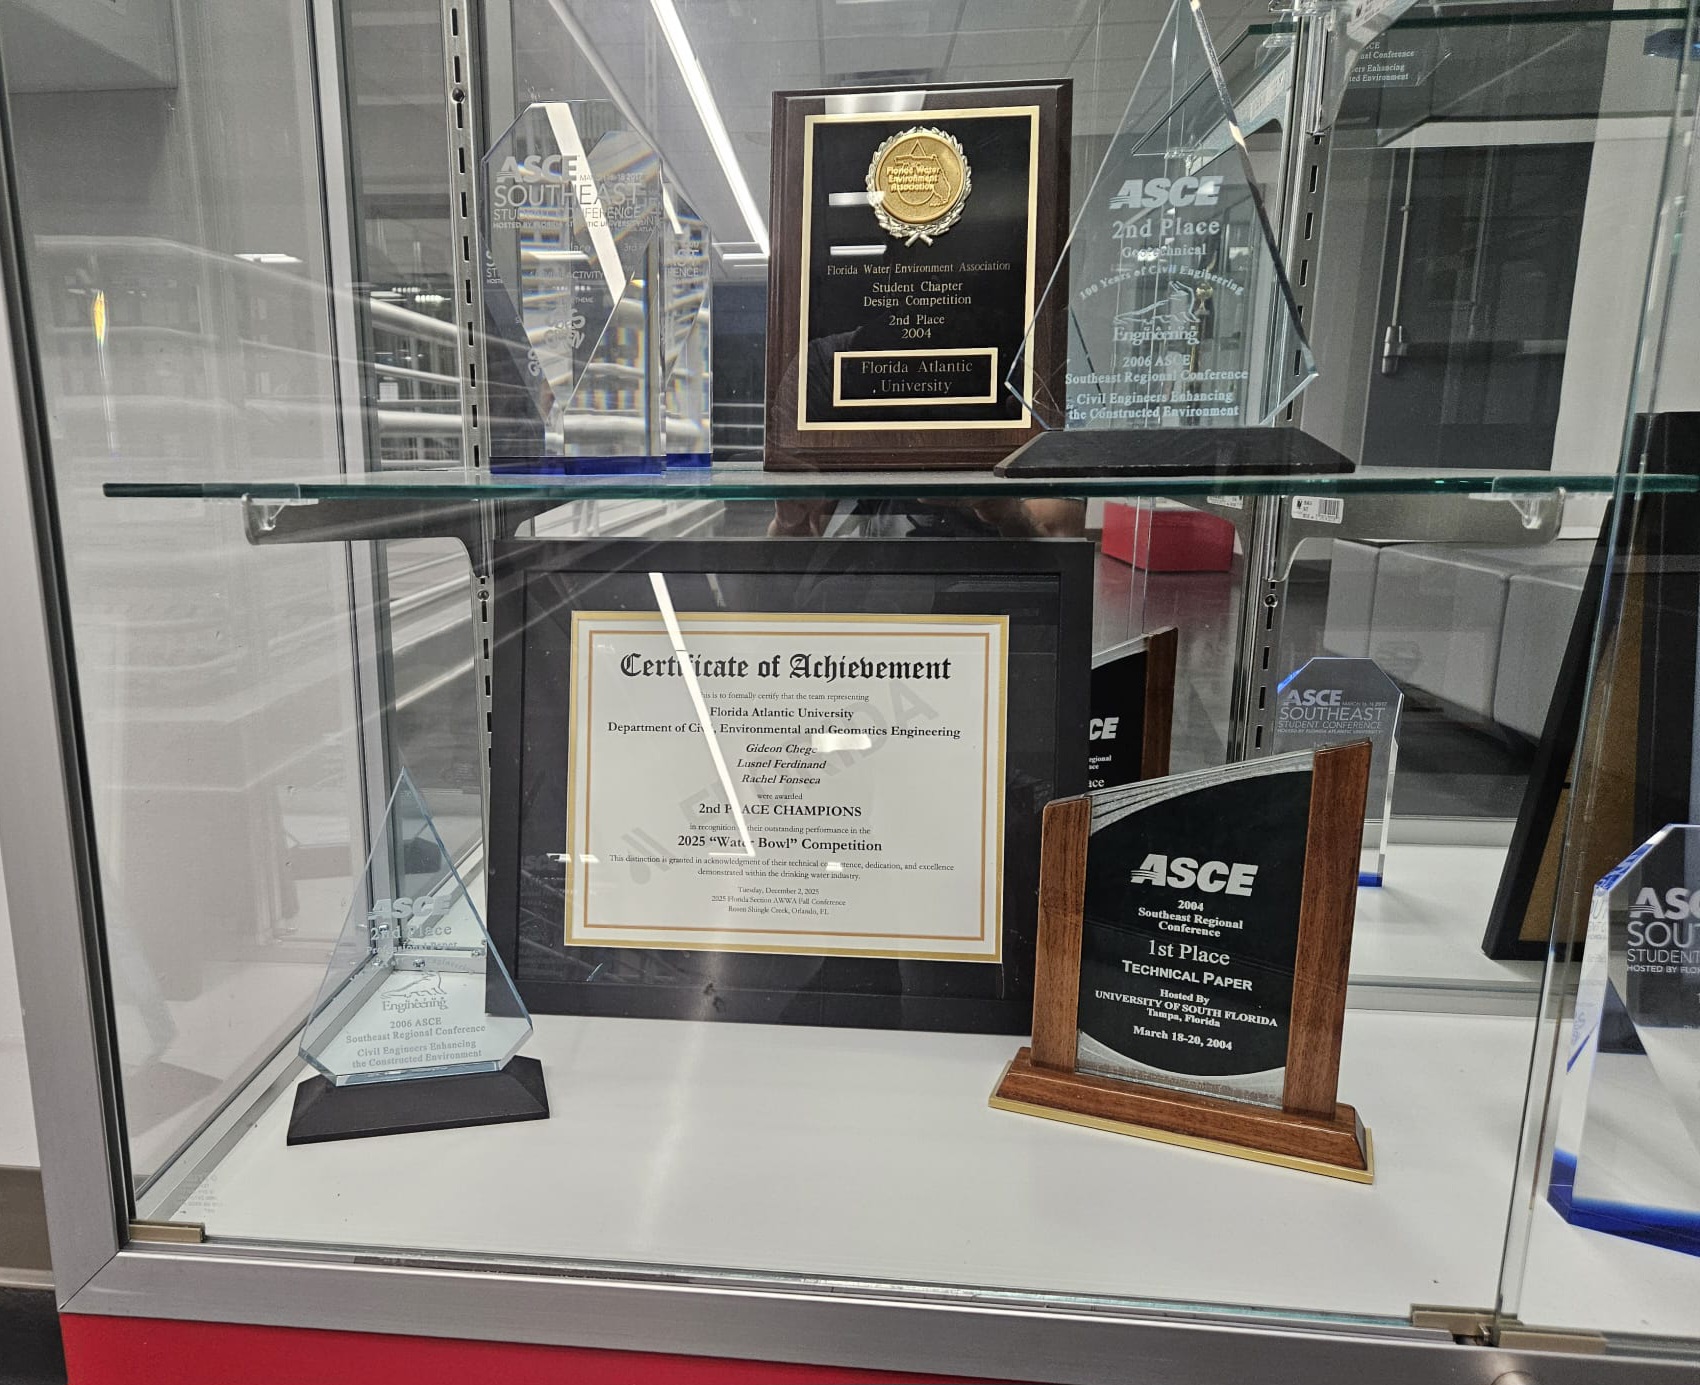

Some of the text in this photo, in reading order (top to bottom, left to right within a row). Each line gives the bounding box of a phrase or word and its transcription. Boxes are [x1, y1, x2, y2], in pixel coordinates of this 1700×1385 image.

[496, 154, 577, 183] ASCE
[888, 174, 939, 184] Environment
[494, 184, 642, 207] SOUTHEAST
[1109, 175, 1224, 210] ASCE
[1112, 218, 1220, 239] 2nd Place
[827, 261, 1011, 275] Florida Water Environment Association
[872, 281, 963, 293] Student Chapter
[1079, 284, 1099, 300] 100
[1100, 271, 1131, 289] Years
[1148, 264, 1178, 275] Civil
[1179, 264, 1245, 297] Engineering
[864, 296, 971, 308] Design Competition
[889, 314, 945, 326] 2nd Place
[901, 328, 932, 339] 2004
[1113, 327, 1200, 346] Engineering
[861, 360, 973, 374] Florida Atlantic
[1122, 353, 1191, 368] 2006 ASCE
[1065, 368, 1249, 385] Southeast Regional Conference
[881, 380, 952, 394] University
[1076, 390, 1233, 406] Civil Engineers Enhancing
[1069, 405, 1239, 420] the Constructed Environment
[757, 653, 952, 683] of Achievement
[719, 692, 727, 700] to
[728, 691, 755, 701] formally
[757, 691, 779, 701] certify
[781, 692, 794, 700] that
[808, 693, 826, 701] team
[827, 693, 870, 703] representing
[1283, 689, 1343, 707] ASCE
[710, 706, 854, 721] Florida Atlantic University
[1279, 706, 1386, 721] SOUTHEAST
[607, 721, 961, 739] Department of Environmental and Geomatics Engineering
[1277, 720, 1382, 730] STUDENT CONFERENCE
[745, 743, 818, 757] Gideon Chege
[736, 758, 827, 770] Lusnel Ferdinand
[741, 773, 821, 785] Rachel Fonseca
[699, 803, 862, 817] 2nd PACE CHAMPIONS
[698, 823, 736, 832] recognition
[747, 824, 763, 832] their
[764, 824, 804, 834] outstanding
[805, 826, 849, 836] performance
[859, 827, 871, 835] the
[677, 835, 883, 853] 2025 Bowl” Competition
[609, 854, 955, 871] This distinction is granted in acknowledgment of their technical dedication, and excellence
[697, 868, 744, 877] demonstrated
[768, 870, 780, 878] the
[780, 870, 809, 879] drinking
[830, 871, 861, 881] industry.
[1130, 853, 1259, 897] ASCE
[765, 887, 796, 895] December
[366, 895, 452, 920] ASCE
[772, 897, 797, 905] AWWA
[1177, 899, 1204, 912] 2004
[1138, 907, 1244, 930] Southeast Regional
[370, 925, 402, 940] 2nd
[1158, 921, 1221, 937] Conference
[1148, 939, 1230, 966] 1st Place
[1122, 959, 1253, 992] TECHNICAL PAPER
[1627, 964, 1677, 973] HOSTED BY
[1160, 988, 1210, 1006] Hosted By
[382, 999, 449, 1013] Engineering
[1095, 990, 1278, 1027] UNIVERSITY OF SOUTH FLORIDA
[389, 1017, 442, 1029] 2006 ASCE
[1146, 1007, 1221, 1028] Tampa, Florida
[346, 1024, 486, 1044] Southeast Regional Conference
[1133, 1025, 1233, 1051] March 18-20, 2004
[357, 1040, 477, 1057] Civil Engineers Enhancing
[352, 1050, 482, 1069] the Constructed Environment
